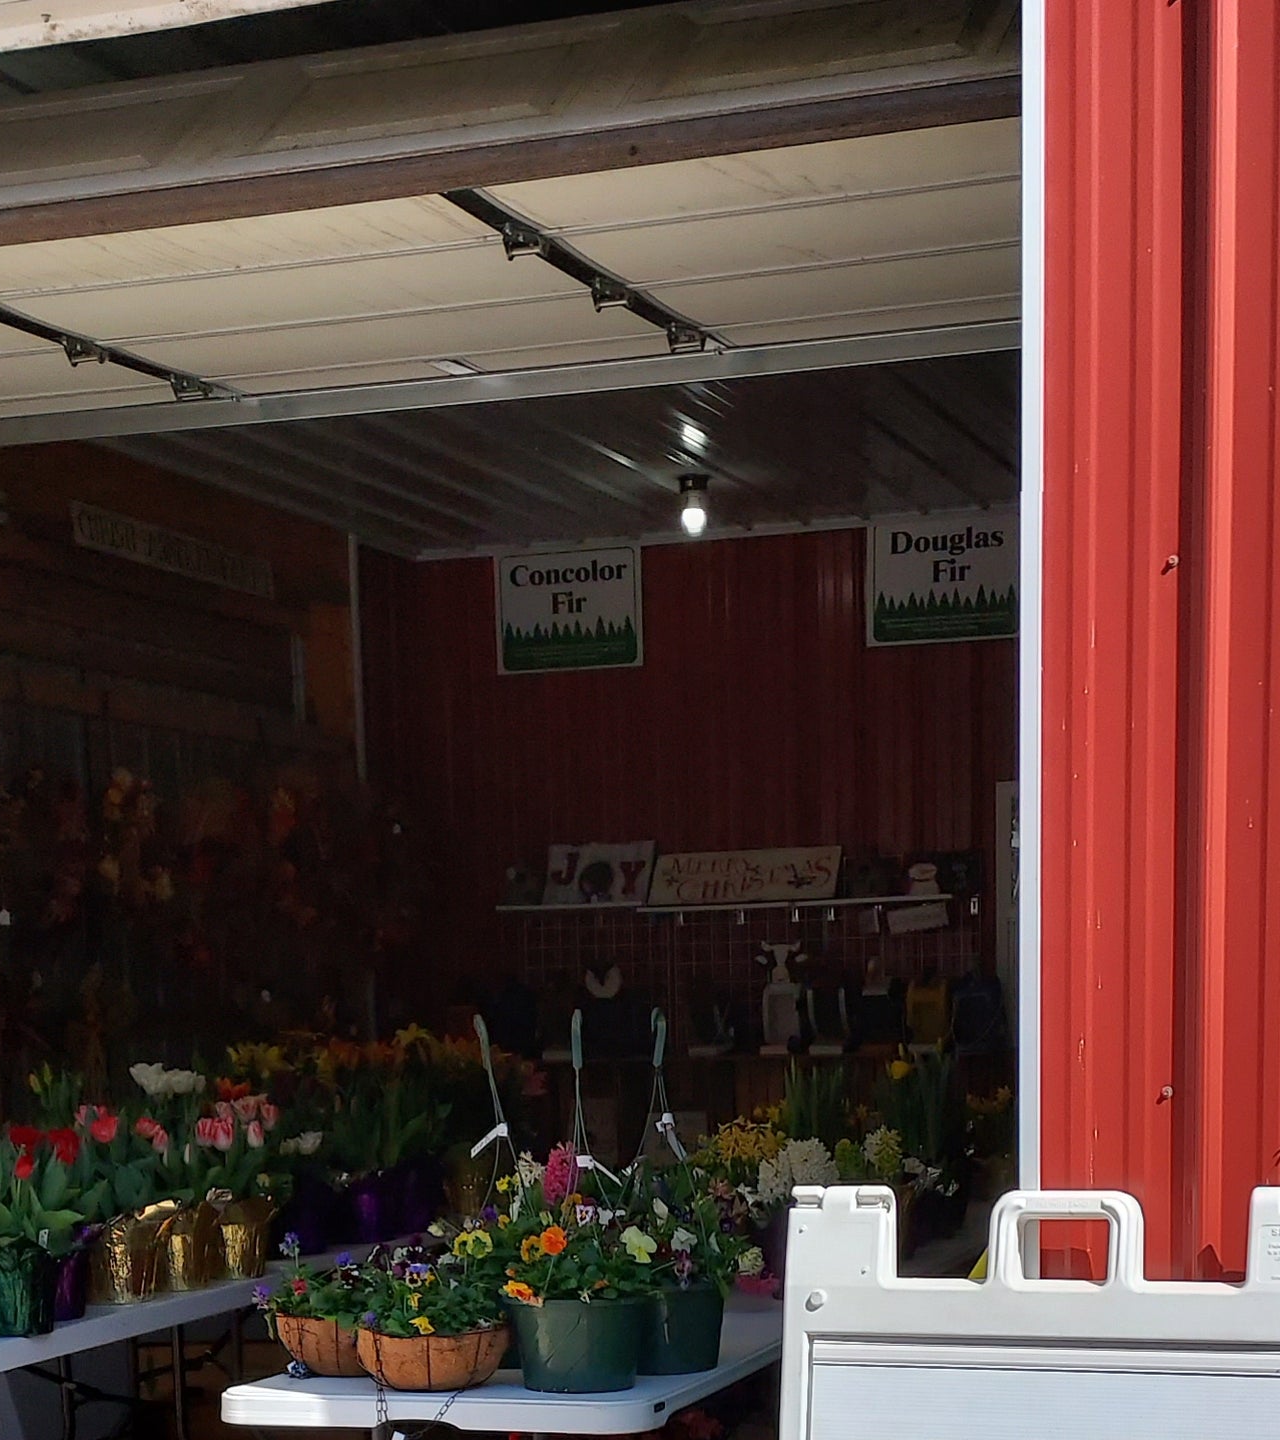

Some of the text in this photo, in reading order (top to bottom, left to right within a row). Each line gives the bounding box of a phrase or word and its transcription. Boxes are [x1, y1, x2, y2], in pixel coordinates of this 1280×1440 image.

[891, 526, 1004, 556] Douglas
[510, 560, 627, 587] Concolor
[932, 558, 971, 583] Fir
[551, 591, 587, 615] Fir
